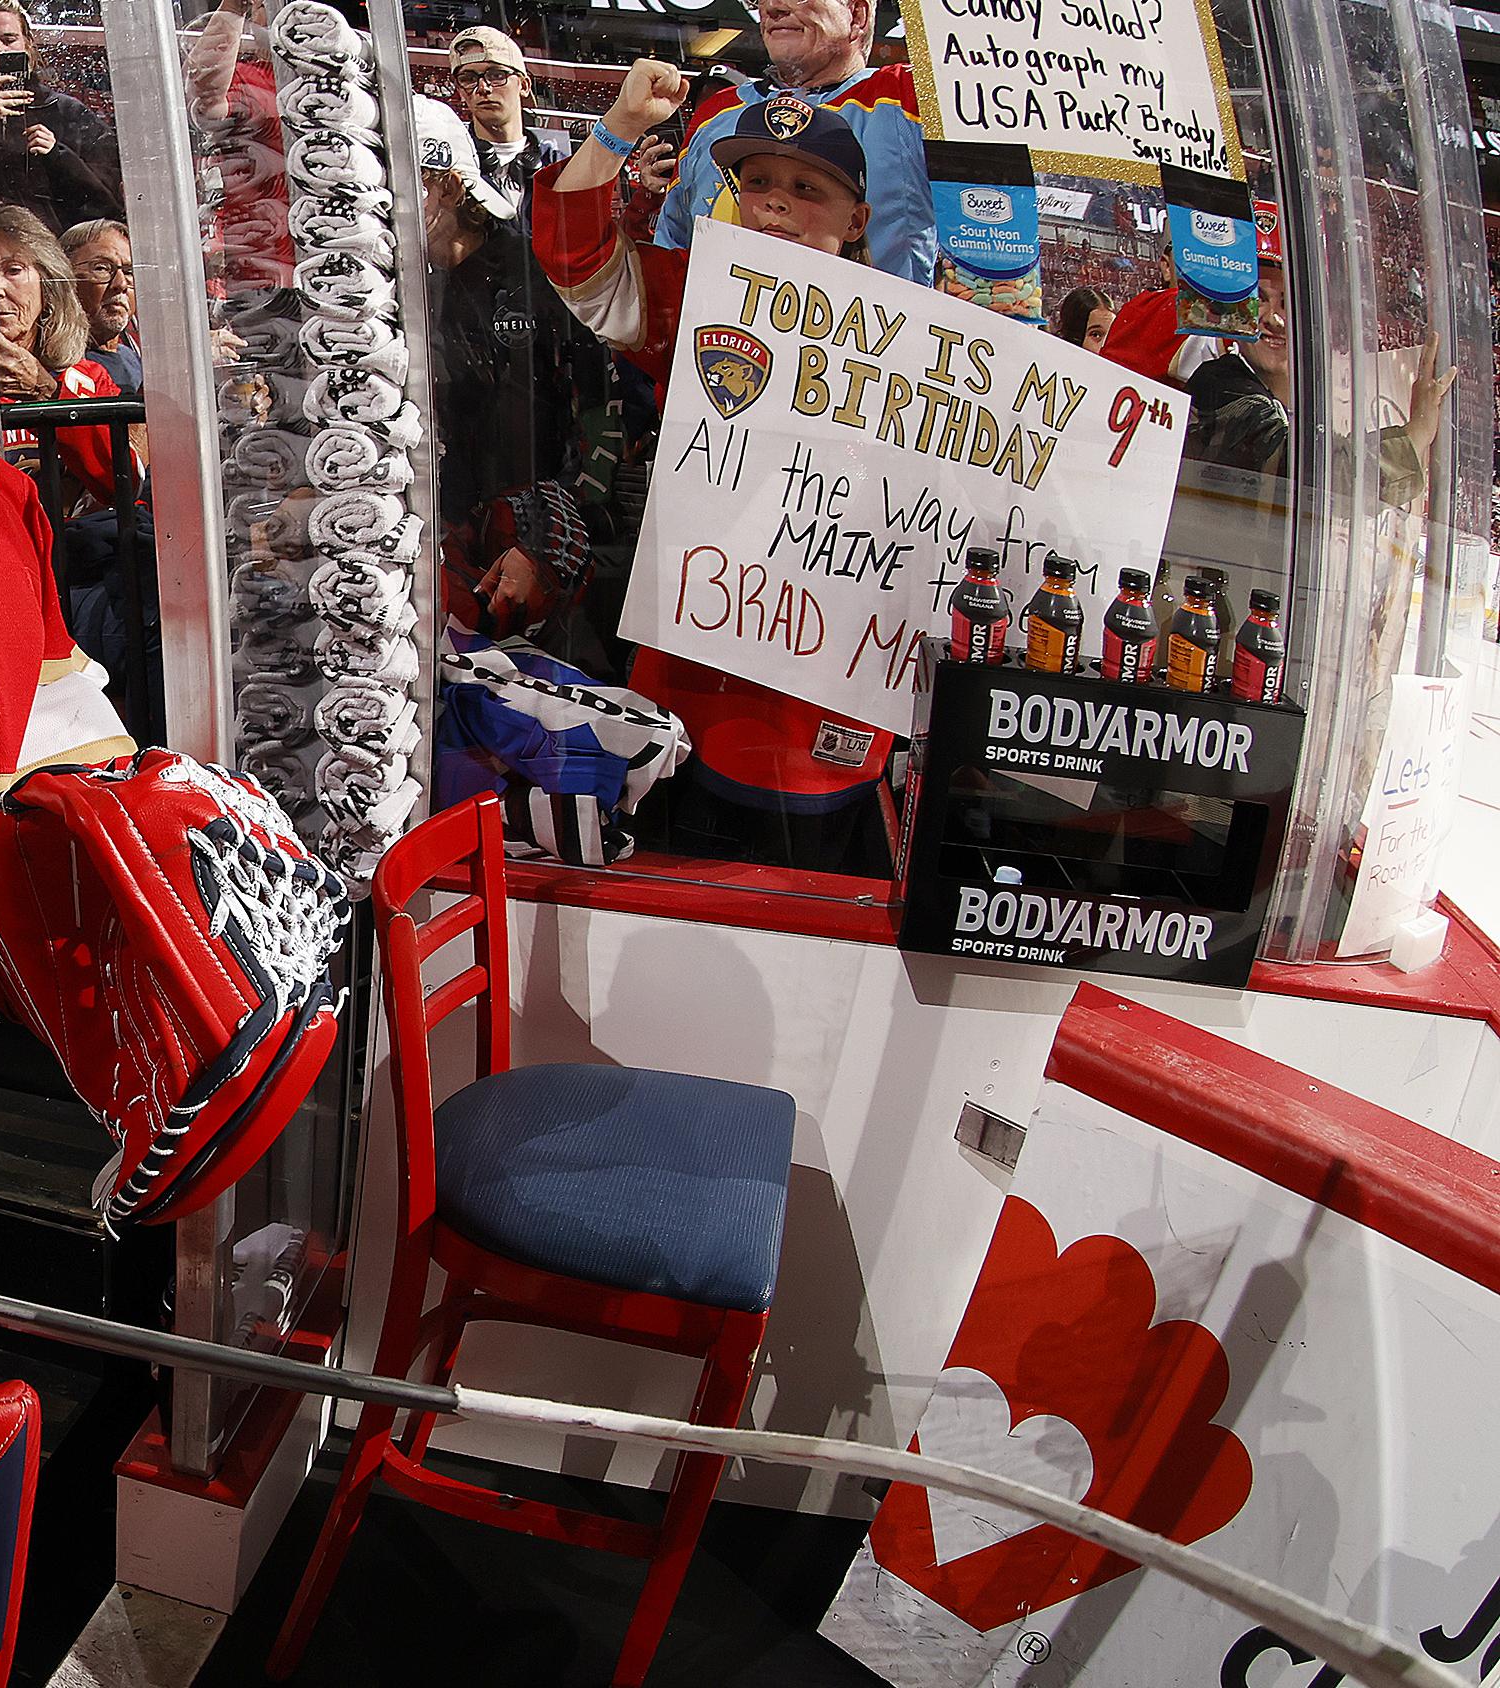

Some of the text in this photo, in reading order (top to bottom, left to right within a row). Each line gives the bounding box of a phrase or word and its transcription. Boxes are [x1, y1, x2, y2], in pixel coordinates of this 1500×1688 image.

[943, 33, 1165, 110] Autograph my
[954, 81, 1216, 154] USA Puck? Brady
[1132, 138, 1173, 164] Says
[966, 192, 1007, 212] Sweet
[1195, 214, 1229, 234] Sweet
[949, 235, 1035, 255] Gummi Worms
[959, 224, 1020, 242] Sour Neon
[1182, 247, 1253, 273] Gummi Bears
[703, 332, 762, 360] FLORIDA
[729, 263, 907, 358] TODAY
[924, 324, 996, 396] IS
[1011, 361, 1089, 433] MY
[789, 343, 1059, 492] BIRTHDAY
[674, 417, 750, 492] All
[781, 441, 851, 520] the
[995, 505, 1099, 595] frm
[767, 512, 915, 591] MAINE
[674, 545, 825, 657] BRAD
[988, 688, 1253, 774] BODYARMOR
[984, 745, 1104, 774] SPORTS DRINK
[955, 886, 1213, 961] BODYARMOR
[951, 937, 1068, 964] SPORTS DRINK
